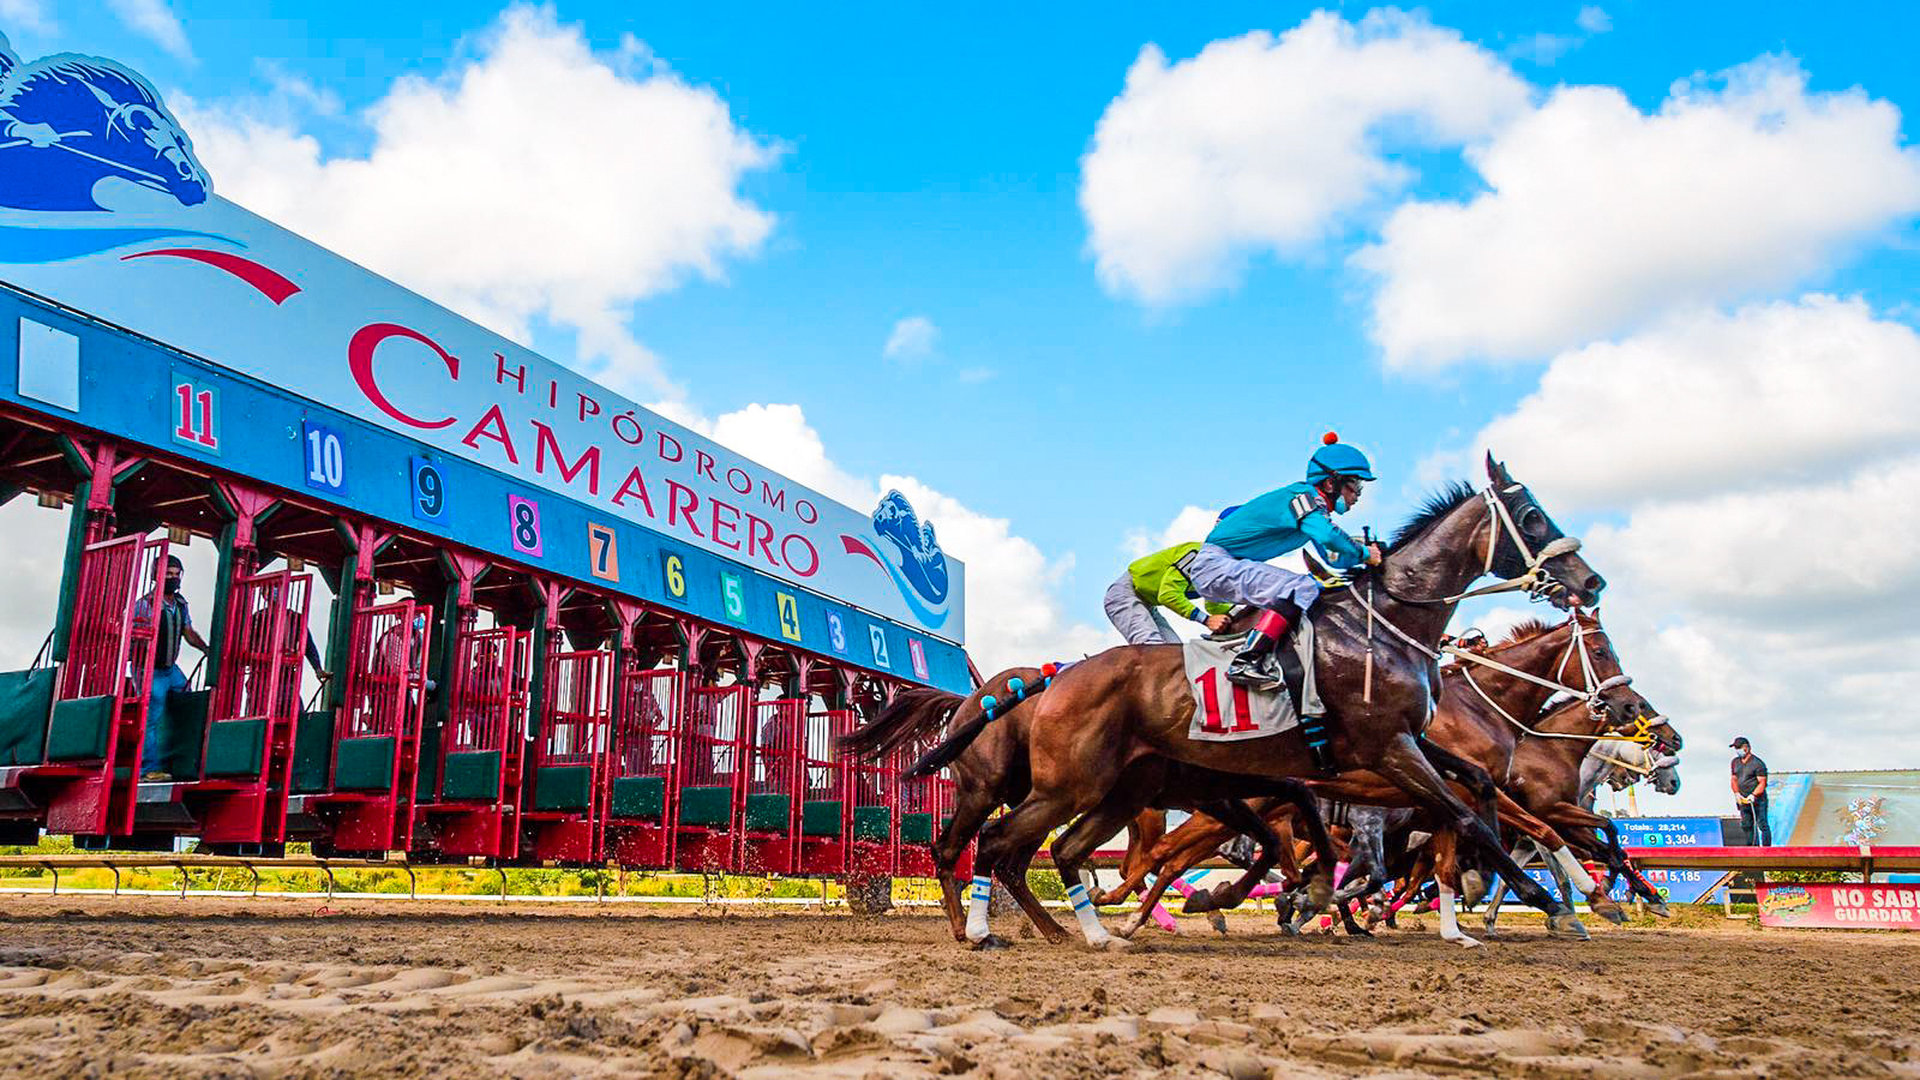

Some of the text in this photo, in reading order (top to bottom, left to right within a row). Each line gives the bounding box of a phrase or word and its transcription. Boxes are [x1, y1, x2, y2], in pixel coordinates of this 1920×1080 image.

[175, 383, 218, 450] 11
[493, 351, 819, 525] HIPÓDROMO
[308, 429, 343, 488] 10
[417, 465, 445, 519] 9
[513, 501, 538, 552] 8
[592, 527, 613, 575] 7
[666, 554, 686, 598] 6
[725, 581, 743, 618] 5
[782, 594, 798, 637] 4
[829, 614, 847, 651] 3
[872, 628, 888, 667] 2
[913, 640, 928, 676] 1
[1194, 667, 1260, 733] 11
[1648, 834, 1657, 845] 9
[1665, 834, 1697, 845] 3,304
[1669, 870, 1701, 883] 5,185
[1831, 888, 1865, 908] NO
[1835, 908, 1913, 922] GUARDAR
